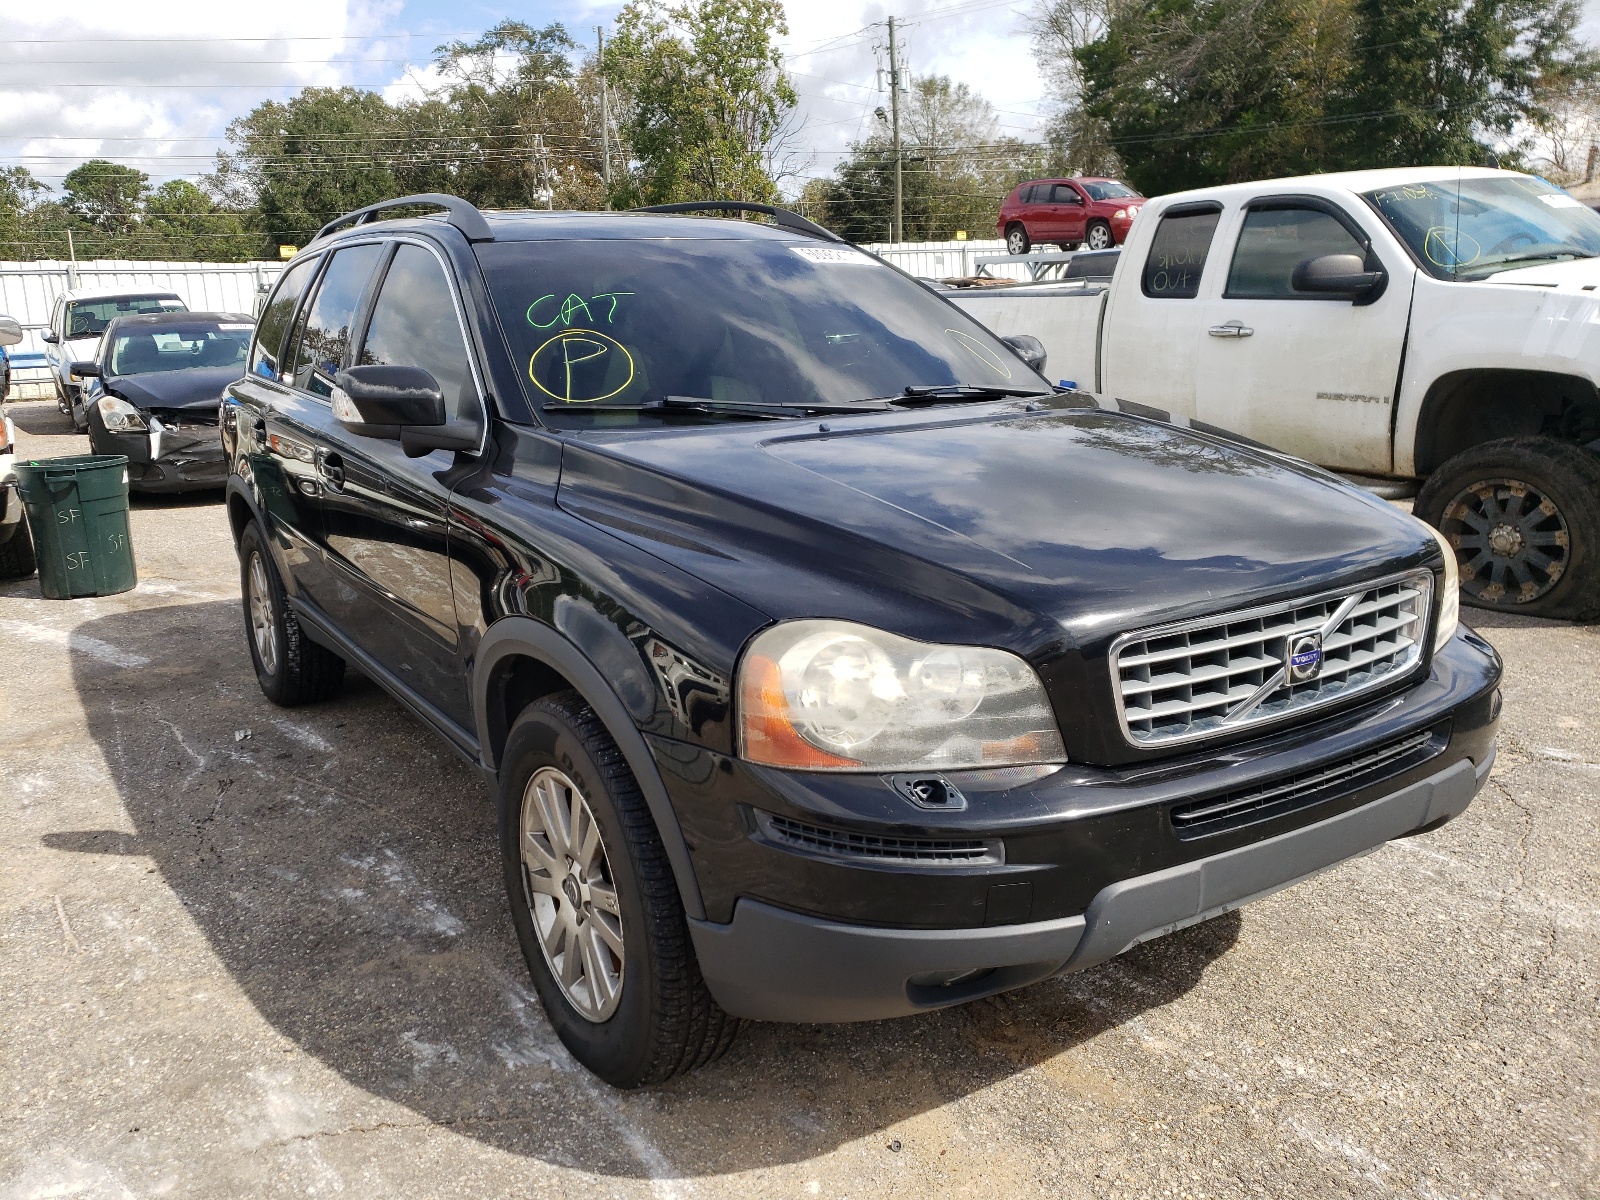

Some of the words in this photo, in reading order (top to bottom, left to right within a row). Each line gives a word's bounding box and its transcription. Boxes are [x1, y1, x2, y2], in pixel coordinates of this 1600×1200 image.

[526, 292, 635, 328] CAT
[563, 338, 608, 402] P
[57, 508, 81, 524] SF
[108, 533, 124, 553] SF
[66, 551, 90, 570] SF
